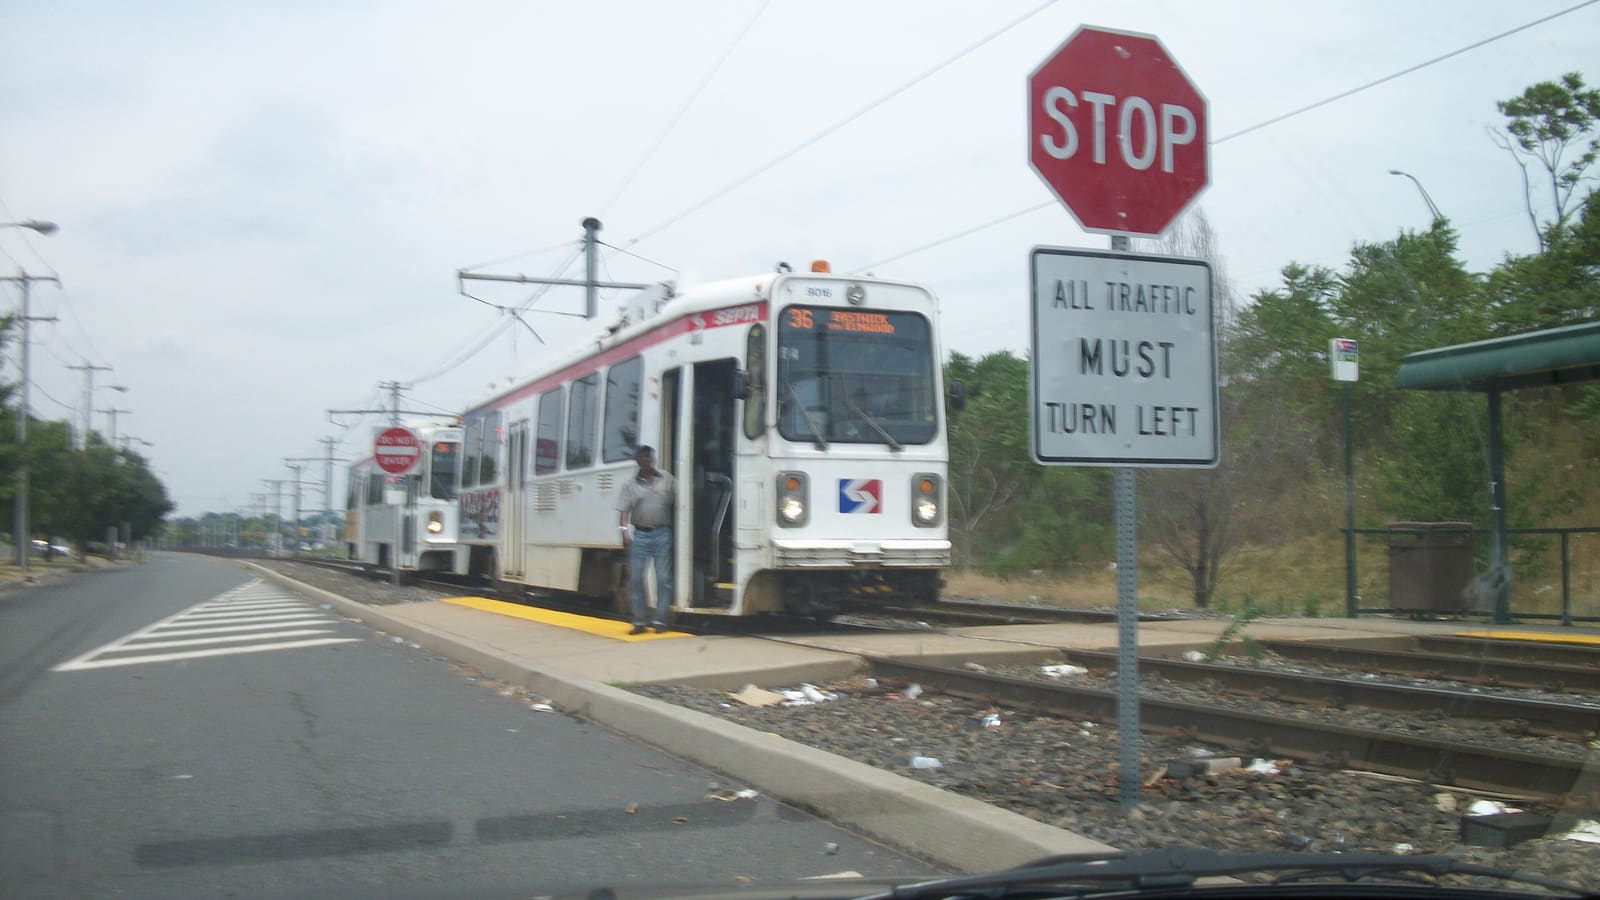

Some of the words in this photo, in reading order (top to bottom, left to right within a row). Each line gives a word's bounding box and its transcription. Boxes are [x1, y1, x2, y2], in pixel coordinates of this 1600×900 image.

[1040, 86, 1197, 173] STOP
[1053, 279, 1095, 310] ALL
[1105, 281, 1196, 316] TRAFFIC
[787, 308, 813, 329] 36
[1079, 337, 1175, 379] MUST
[1044, 402, 1117, 435] TURN
[1136, 405, 1199, 437] LEFT
